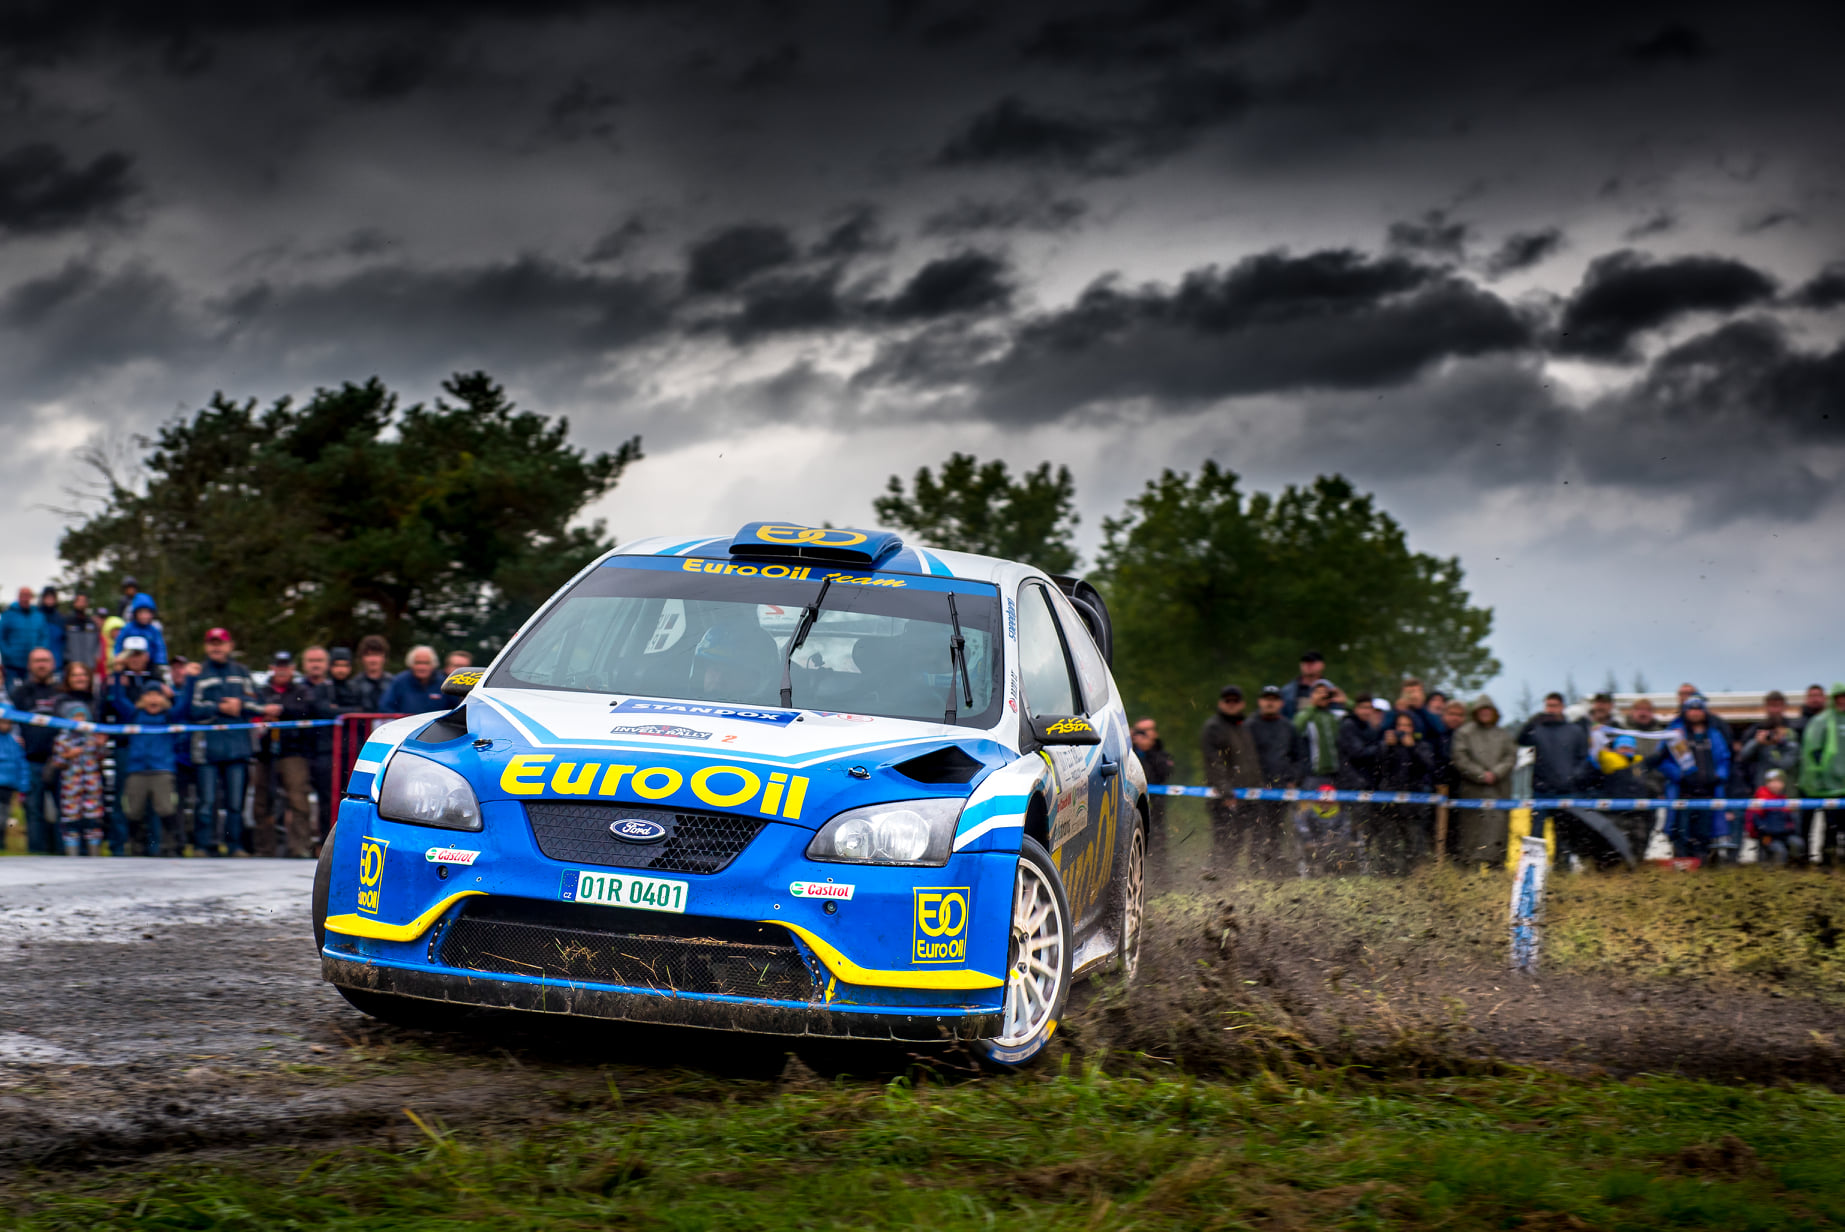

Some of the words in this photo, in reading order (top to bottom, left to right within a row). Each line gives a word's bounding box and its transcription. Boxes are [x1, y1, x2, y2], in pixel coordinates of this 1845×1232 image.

[822, 572, 907, 588] team
[631, 703, 781, 721] STANDOX
[614, 726, 665, 735] INVELT
[666, 729, 711, 738] RALLY
[721, 735, 738, 743] 2
[500, 754, 810, 820] EuroOil
[621, 821, 653, 835] Ford
[438, 849, 475, 863] Castrol
[563, 891, 573, 899] CZ
[580, 875, 623, 902] 01R
[629, 880, 683, 909] 0401
[808, 883, 849, 898] Castrol
